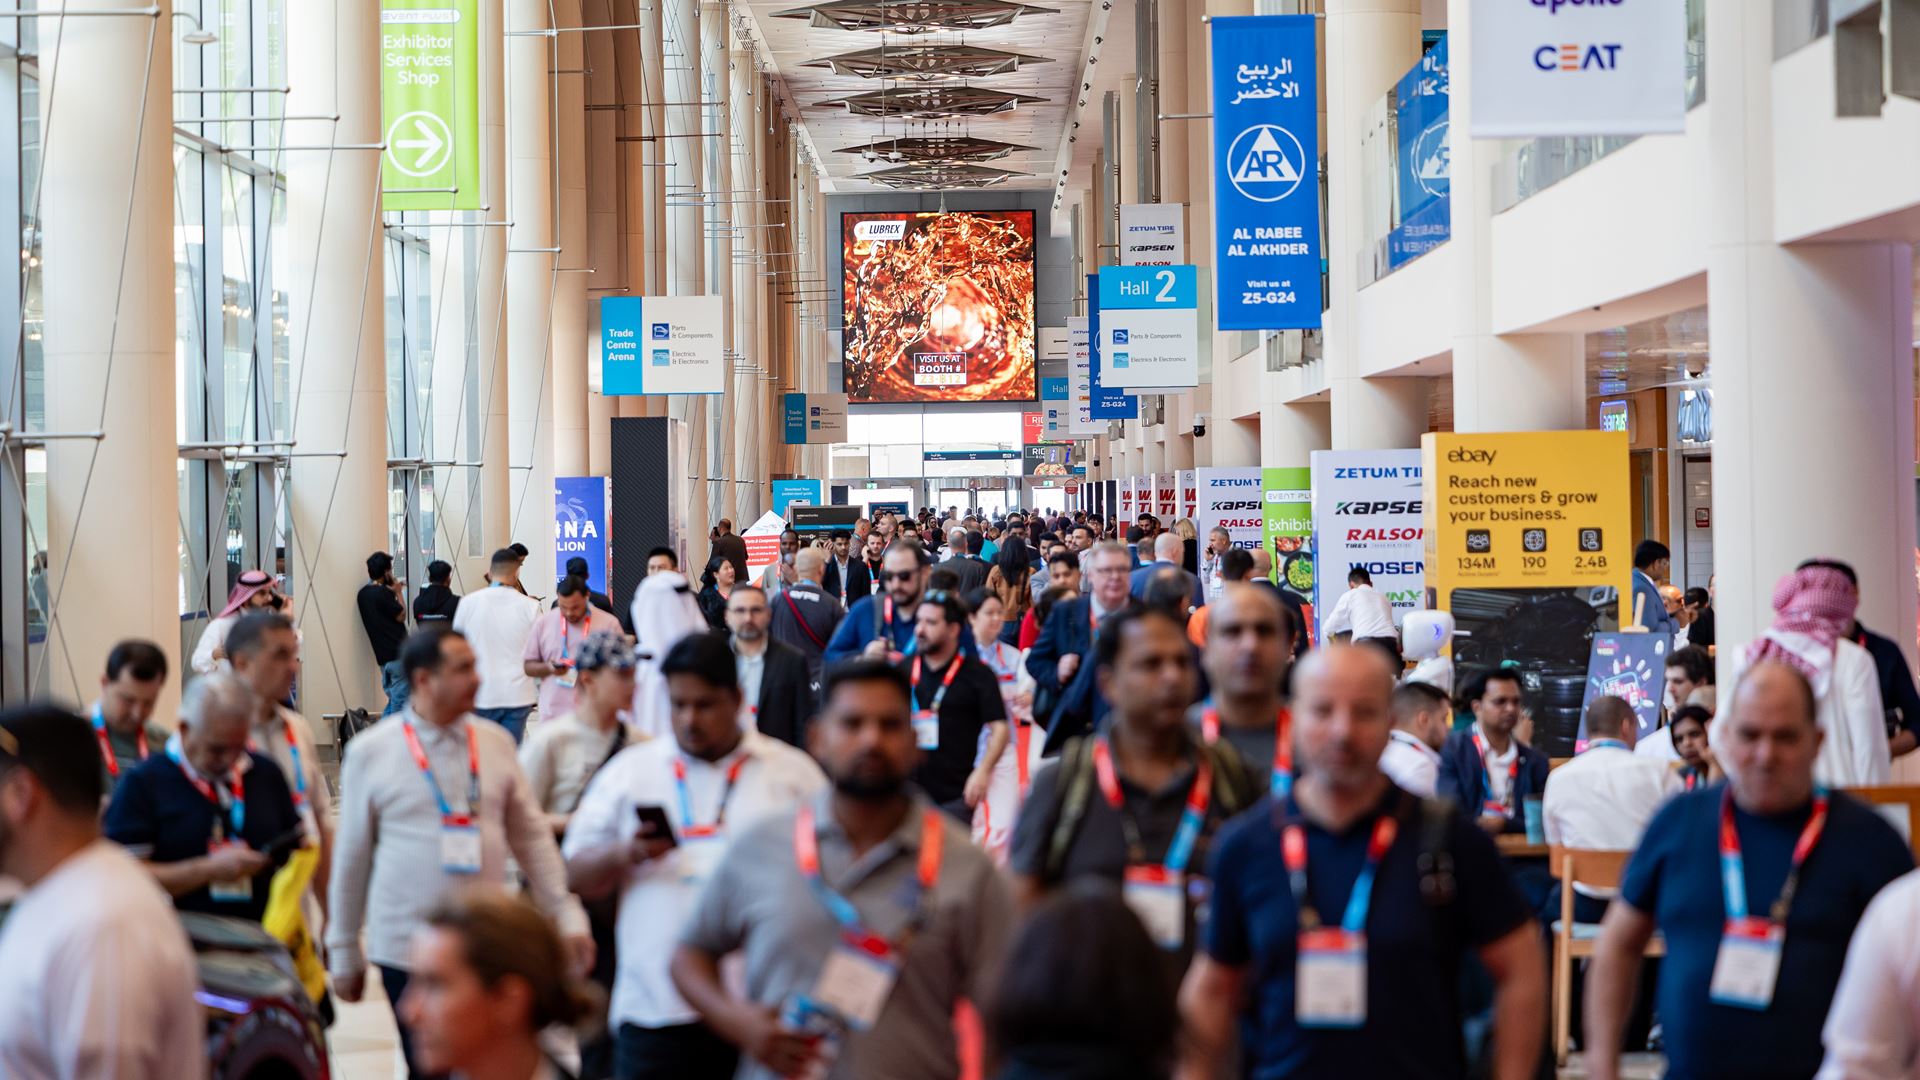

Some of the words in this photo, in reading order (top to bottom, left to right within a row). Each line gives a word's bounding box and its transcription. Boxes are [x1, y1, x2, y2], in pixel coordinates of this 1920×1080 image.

[383, 33, 453, 49] Exhibitor
[385, 52, 453, 68] Services
[1533, 44, 1622, 71] CEAT
[1236, 57, 1292, 84] الربيع
[397, 69, 440, 88] Shop
[1243, 150, 1285, 178] AR
[869, 224, 900, 234] LUBREX
[1233, 228, 1252, 240] AL
[1255, 226, 1302, 240] RABEE
[1227, 244, 1246, 256] AL
[1249, 243, 1309, 256] AKHDER
[1120, 280, 1149, 296] Hall
[1155, 269, 1177, 303] 2
[1246, 280, 1267, 288] Visit
[1281, 280, 1291, 288] at
[1242, 291, 1296, 304] Z5-G24
[608, 329, 634, 338] Trade
[606, 341, 637, 350] Centre
[607, 353, 635, 361] Arena
[919, 355, 938, 363] VISIT
[939, 355, 950, 363] US
[950, 355, 960, 363] AT
[919, 365, 953, 373] BOOTH
[1052, 385, 1068, 393] Hall
[1447, 446, 1497, 466] ebay
[1334, 467, 1398, 479] ZETUM
[1210, 479, 1252, 487] ZETUM
[1449, 475, 1500, 488] Reach
[1504, 477, 1537, 488] new
[1449, 491, 1536, 505] customers
[1540, 490, 1553, 503] &
[1557, 493, 1598, 506] grow
[1450, 511, 1486, 524] your
[1490, 508, 1567, 521] business.
[557, 541, 586, 552] LION
[1457, 557, 1496, 569] 134M
[1521, 556, 1546, 569] 190
[1574, 556, 1607, 568] 2.4B
